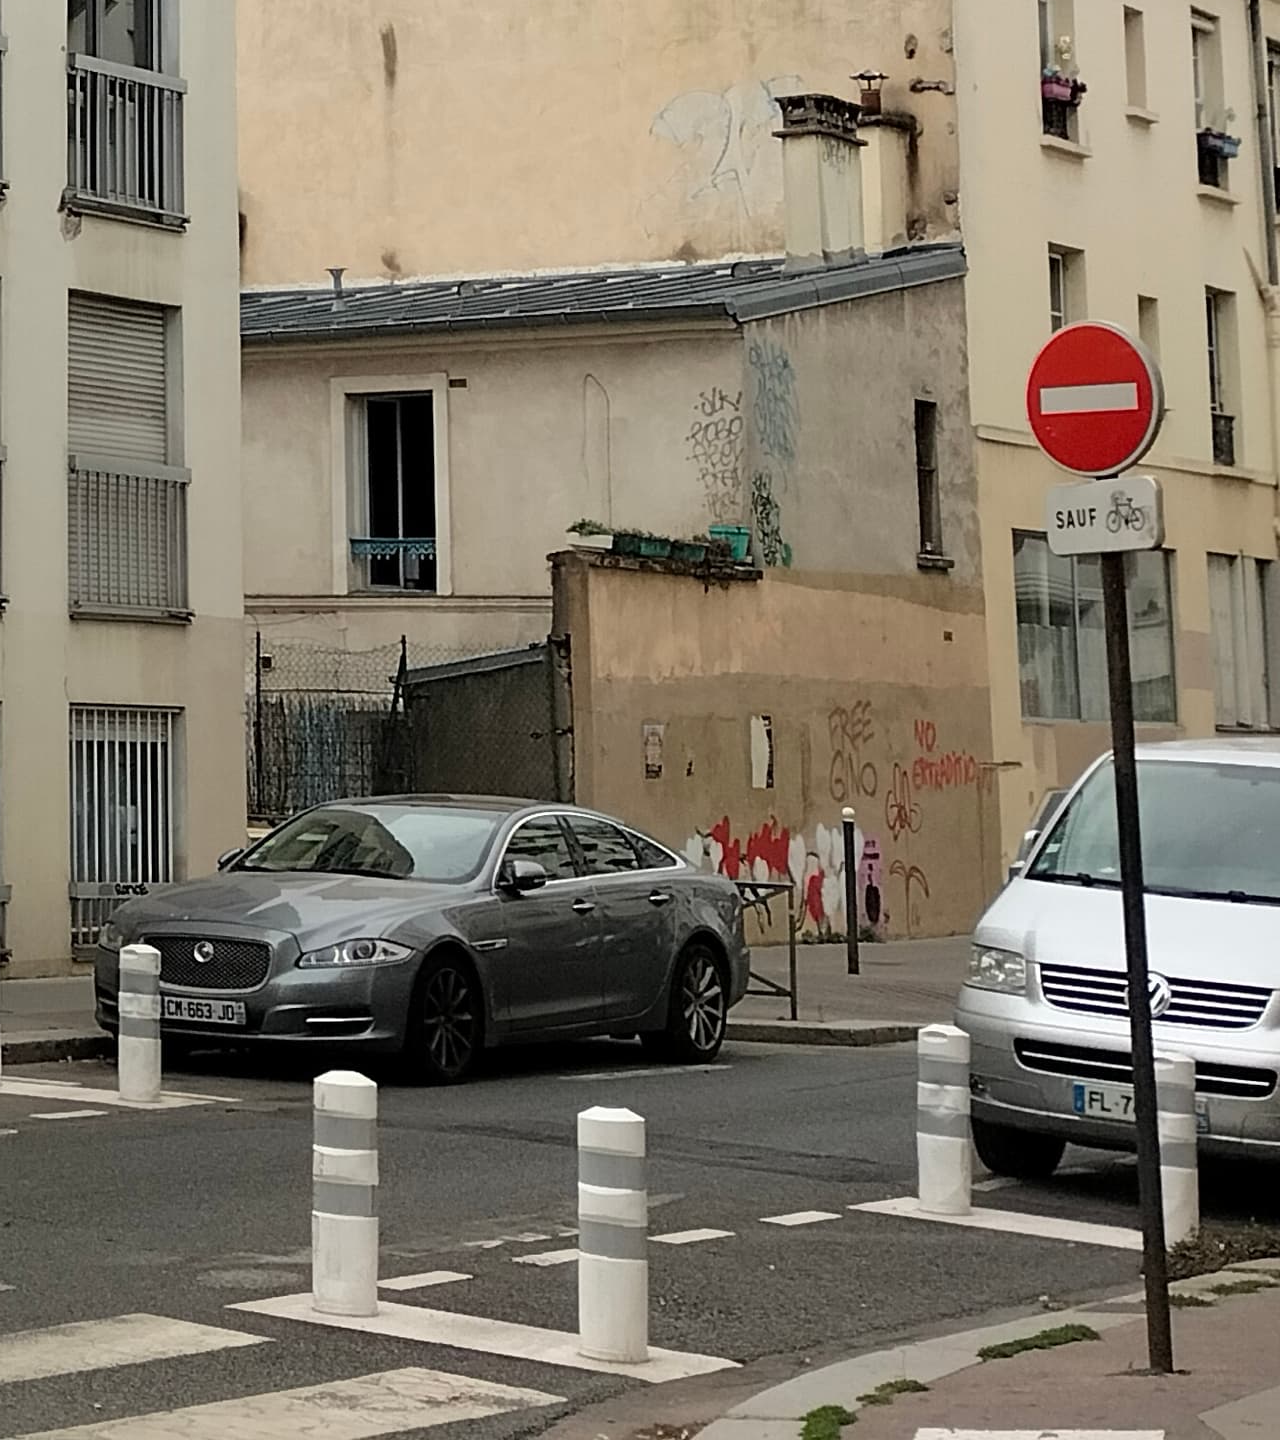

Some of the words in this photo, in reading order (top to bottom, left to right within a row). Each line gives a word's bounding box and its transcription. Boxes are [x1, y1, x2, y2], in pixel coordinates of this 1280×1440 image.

[1055, 508, 1097, 530] SAUF
[828, 700, 875, 752] FREE
[914, 719, 937, 753] NO
